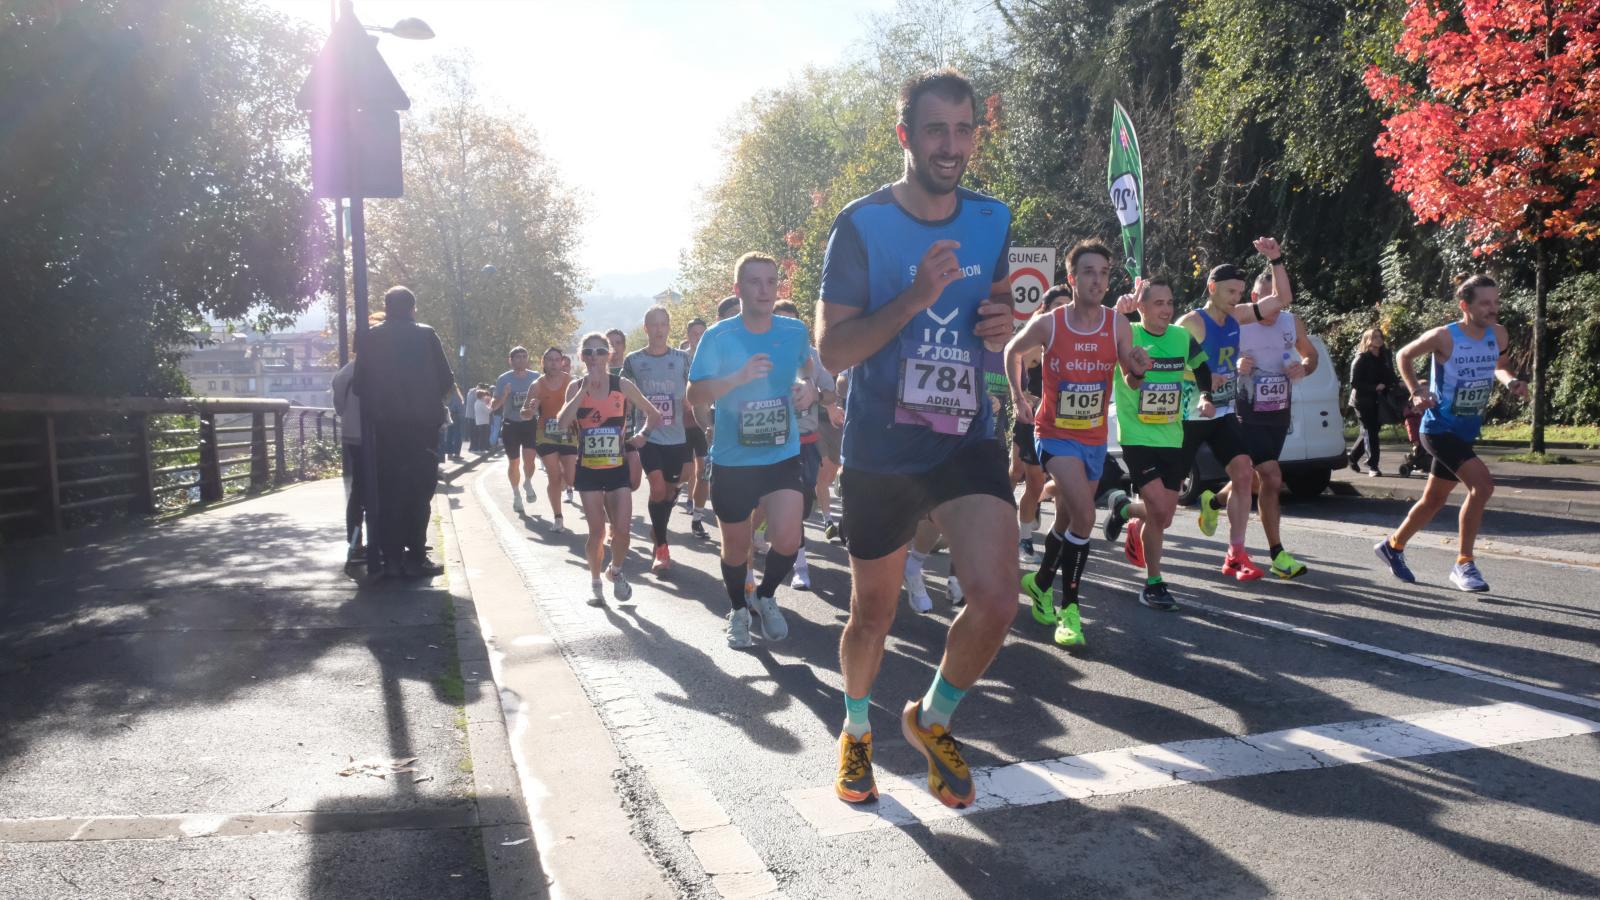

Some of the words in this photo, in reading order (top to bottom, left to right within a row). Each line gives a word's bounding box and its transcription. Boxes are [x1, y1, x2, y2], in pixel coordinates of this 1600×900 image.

[1008, 252, 1048, 263] GUNEA
[1014, 286, 1040, 303] 30
[1074, 343, 1098, 352] IKER
[915, 363, 972, 395] 784
[1260, 384, 1285, 396] 640
[926, 395, 960, 408] ADRIA
[1066, 393, 1099, 408] 105
[1146, 392, 1176, 405] 243
[743, 409, 786, 427] 2245
[588, 436, 616, 448] 317
